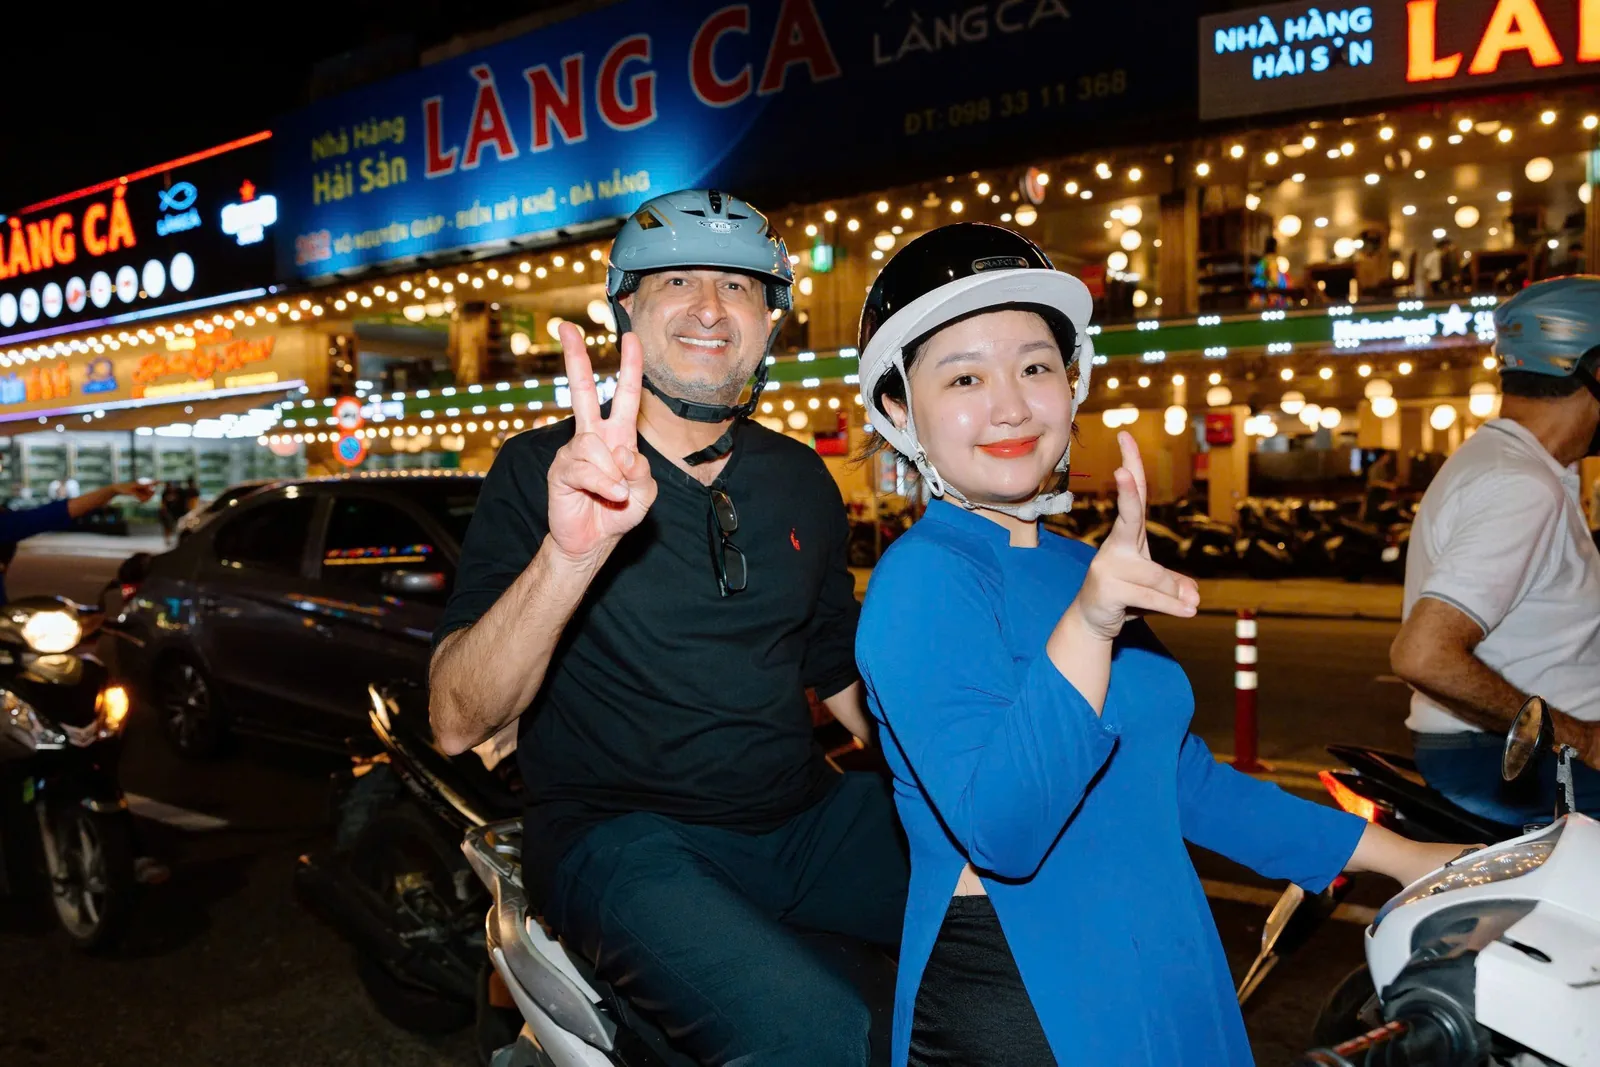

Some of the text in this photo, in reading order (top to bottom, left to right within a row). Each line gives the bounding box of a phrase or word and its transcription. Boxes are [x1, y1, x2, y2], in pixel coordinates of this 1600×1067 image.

[871, 5, 990, 67] LÀNG
[1214, 6, 1373, 54] NHÀ HÀNG
[1406, 0, 1600, 83] LA
[1252, 45, 1305, 80] HẢI
[422, 34, 657, 180] LÀNG
[948, 95, 991, 128] 098
[999, 89, 1030, 118] 33
[1040, 81, 1067, 108] 11
[1076, 67, 1128, 101] 368
[312, 151, 408, 206] Hải Sản
[82, 184, 137, 257] CÁ
